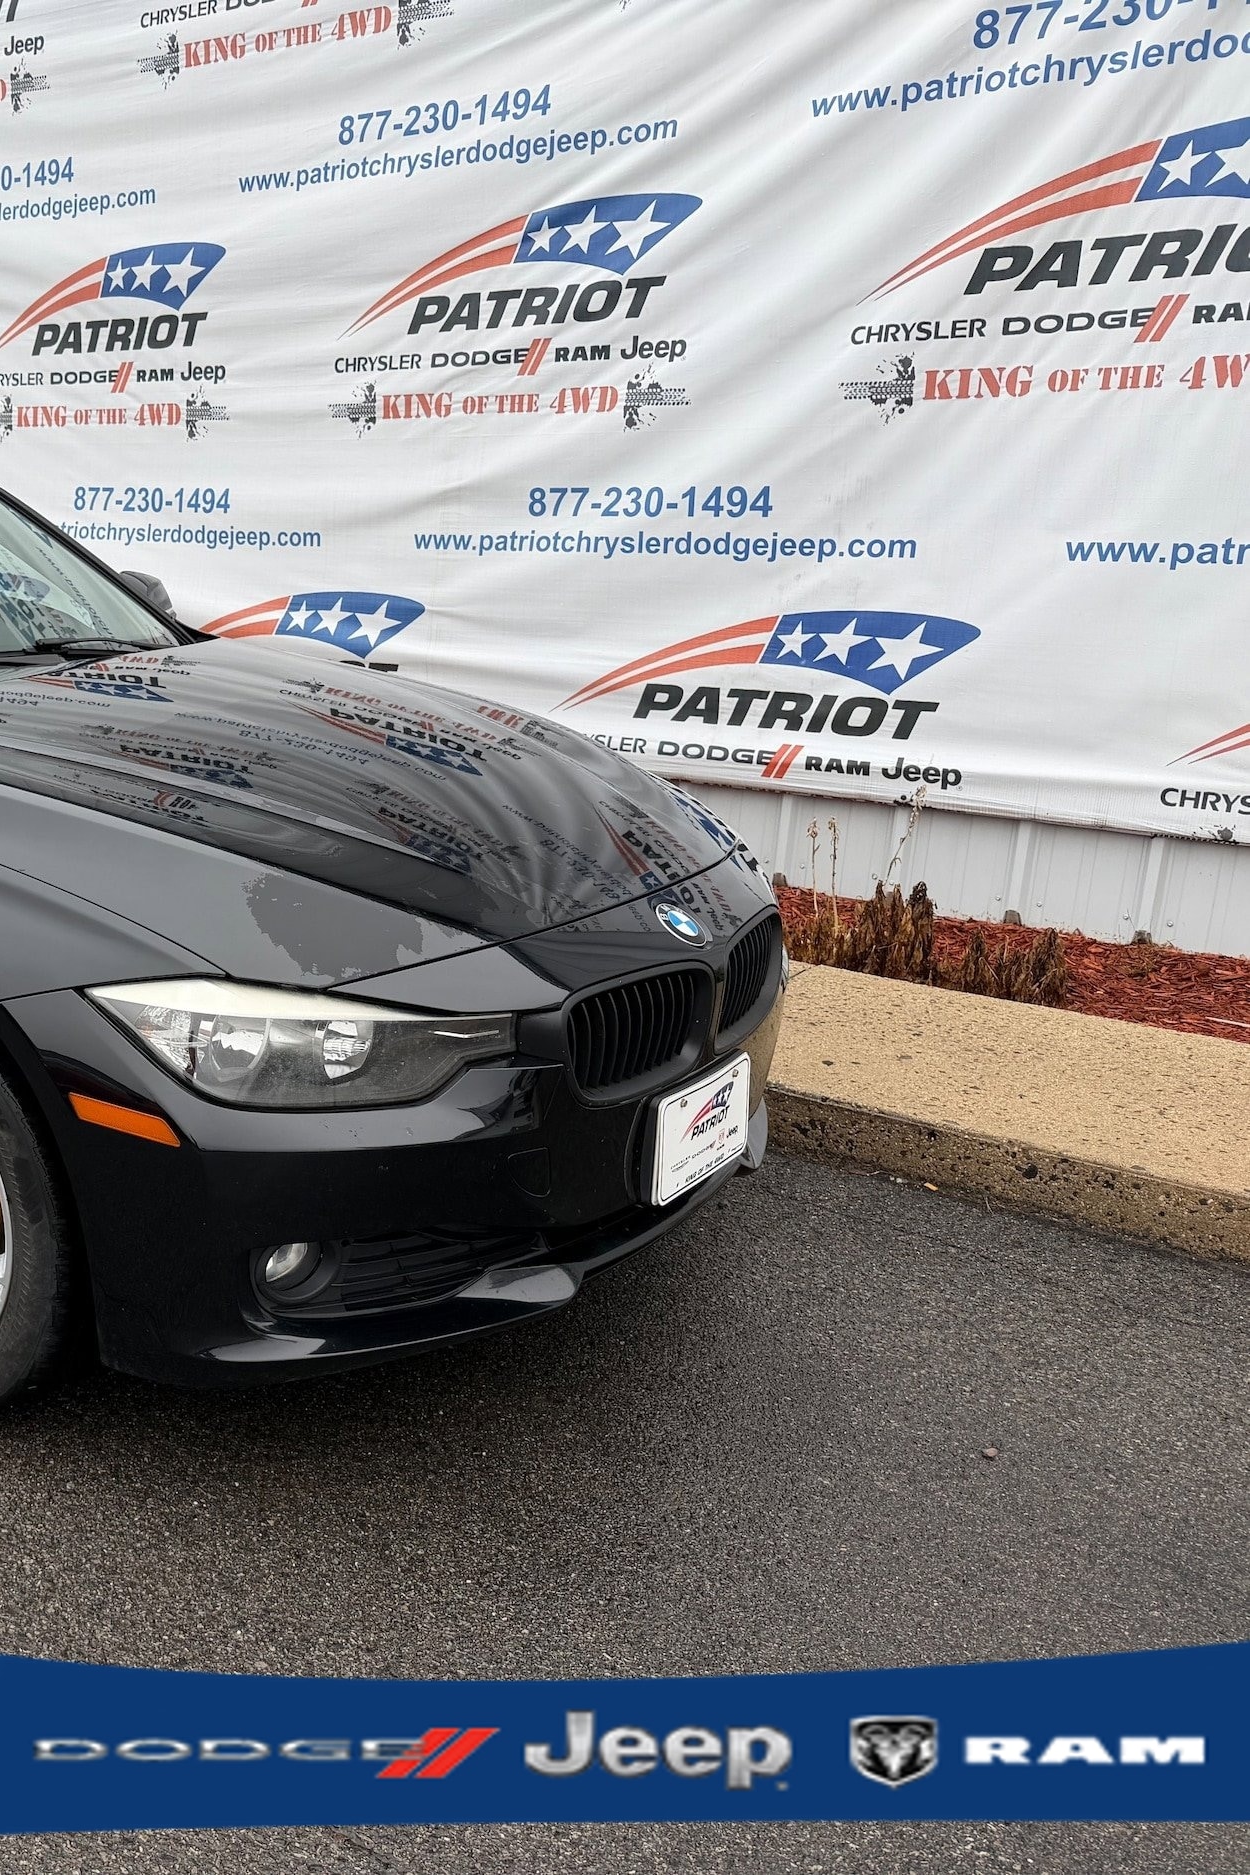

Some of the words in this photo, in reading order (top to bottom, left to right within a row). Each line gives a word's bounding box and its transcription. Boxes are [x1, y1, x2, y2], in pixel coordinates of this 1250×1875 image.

[141, 0, 217, 28] CHRYSLER
[4, 36, 44, 56] Jeep
[184, 33, 246, 67] KING
[255, 31, 278, 52] OF
[283, 23, 322, 47] THE
[331, 6, 391, 40] 4WD
[338, 84, 552, 146] 877-230-1494
[238, 117, 679, 194] www.patriotchryslerdodgejeep.com
[407, 275, 667, 335] PATRIOT
[31, 311, 209, 357] PATRIOT
[851, 319, 986, 344] CHRYSLER
[1001, 306, 1155, 336] DODGE
[1192, 303, 1250, 324] RA
[335, 354, 421, 373] CHRYSLER
[430, 347, 527, 370] DODGE
[555, 344, 610, 362] RAM
[621, 335, 686, 362] Jeep
[49, 369, 118, 385] DODGE
[137, 368, 173, 382] RAM
[181, 361, 225, 384] Jeep
[922, 365, 1033, 400] KING
[1048, 369, 1089, 392] OF
[1098, 365, 1165, 390] THE
[17, 406, 67, 427] KING
[74, 409, 92, 424] OF
[96, 409, 126, 424] THE
[134, 403, 181, 425] 4WD
[382, 392, 452, 419] KING
[462, 396, 489, 414] OF
[495, 394, 539, 413] THE
[550, 386, 618, 414] 4WD
[74, 487, 230, 513] 877-230-1494
[529, 486, 773, 518] 877-230-1494
[415, 530, 916, 562] www.patriotchryslerdodgejeep.com
[633, 684, 940, 740] PATRIOT
[657, 740, 771, 766] DODGE
[805, 756, 870, 776] RAM
[882, 758, 962, 790] Jeep
[691, 1105, 730, 1140] PATRIOT
